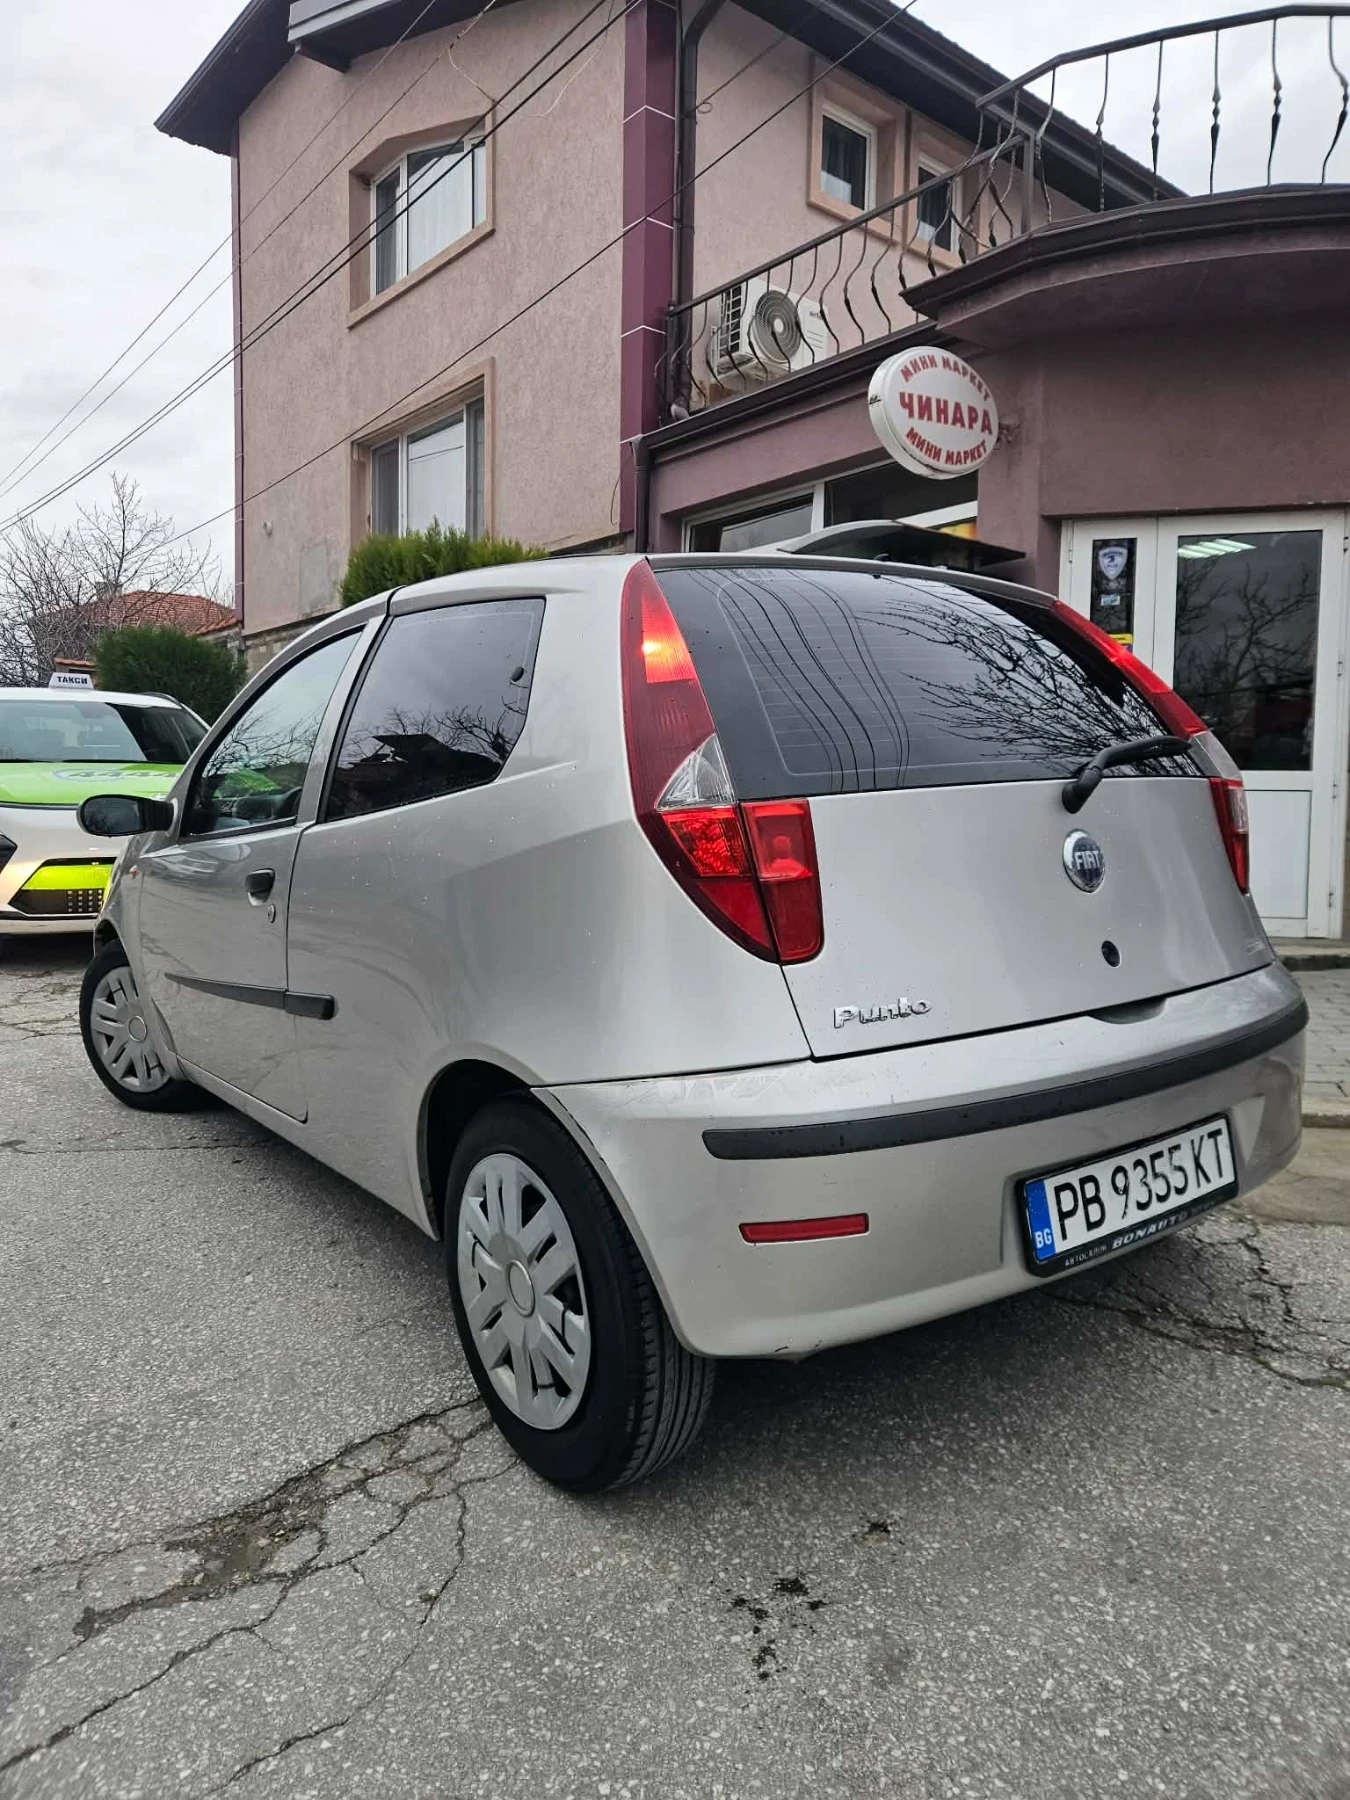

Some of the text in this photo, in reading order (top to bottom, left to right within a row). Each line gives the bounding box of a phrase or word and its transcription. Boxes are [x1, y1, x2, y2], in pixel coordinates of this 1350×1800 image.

[900, 354, 991, 402] МИНИ МАРКЕТ
[899, 391, 993, 436] ЧИНАРА
[906, 426, 987, 466] МИНИ МАРКЕТ
[57, 675, 88, 685] ТАКСИ
[1074, 850, 1101, 870] FIAT
[833, 997, 932, 1030] Punto
[1053, 1128, 1224, 1241] PB 9355 KT
[1035, 1230, 1053, 1249] BG
